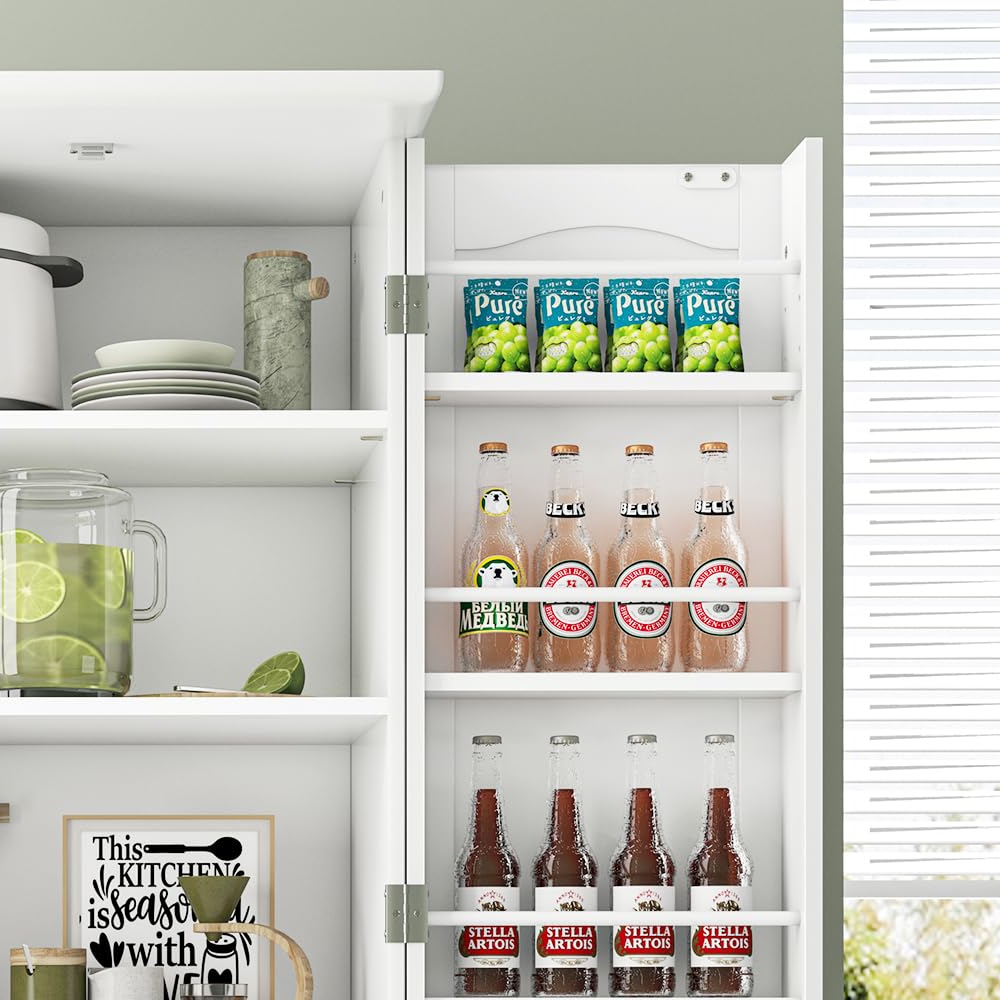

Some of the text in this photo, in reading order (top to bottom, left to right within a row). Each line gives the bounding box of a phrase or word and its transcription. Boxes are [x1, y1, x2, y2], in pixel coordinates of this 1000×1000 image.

[92, 834, 143, 861] This
[87, 897, 110, 929] is
[468, 927, 514, 938] STELLA
[546, 927, 592, 938] STELLA
[624, 926, 670, 936] STELLA
[702, 926, 748, 936] STELLA
[126, 931, 198, 967] with
[468, 939, 514, 950] ARTOIS
[546, 939, 592, 950] ARTOIS
[624, 938, 670, 949] ARTOIS
[702, 938, 748, 949] ARTOIS
